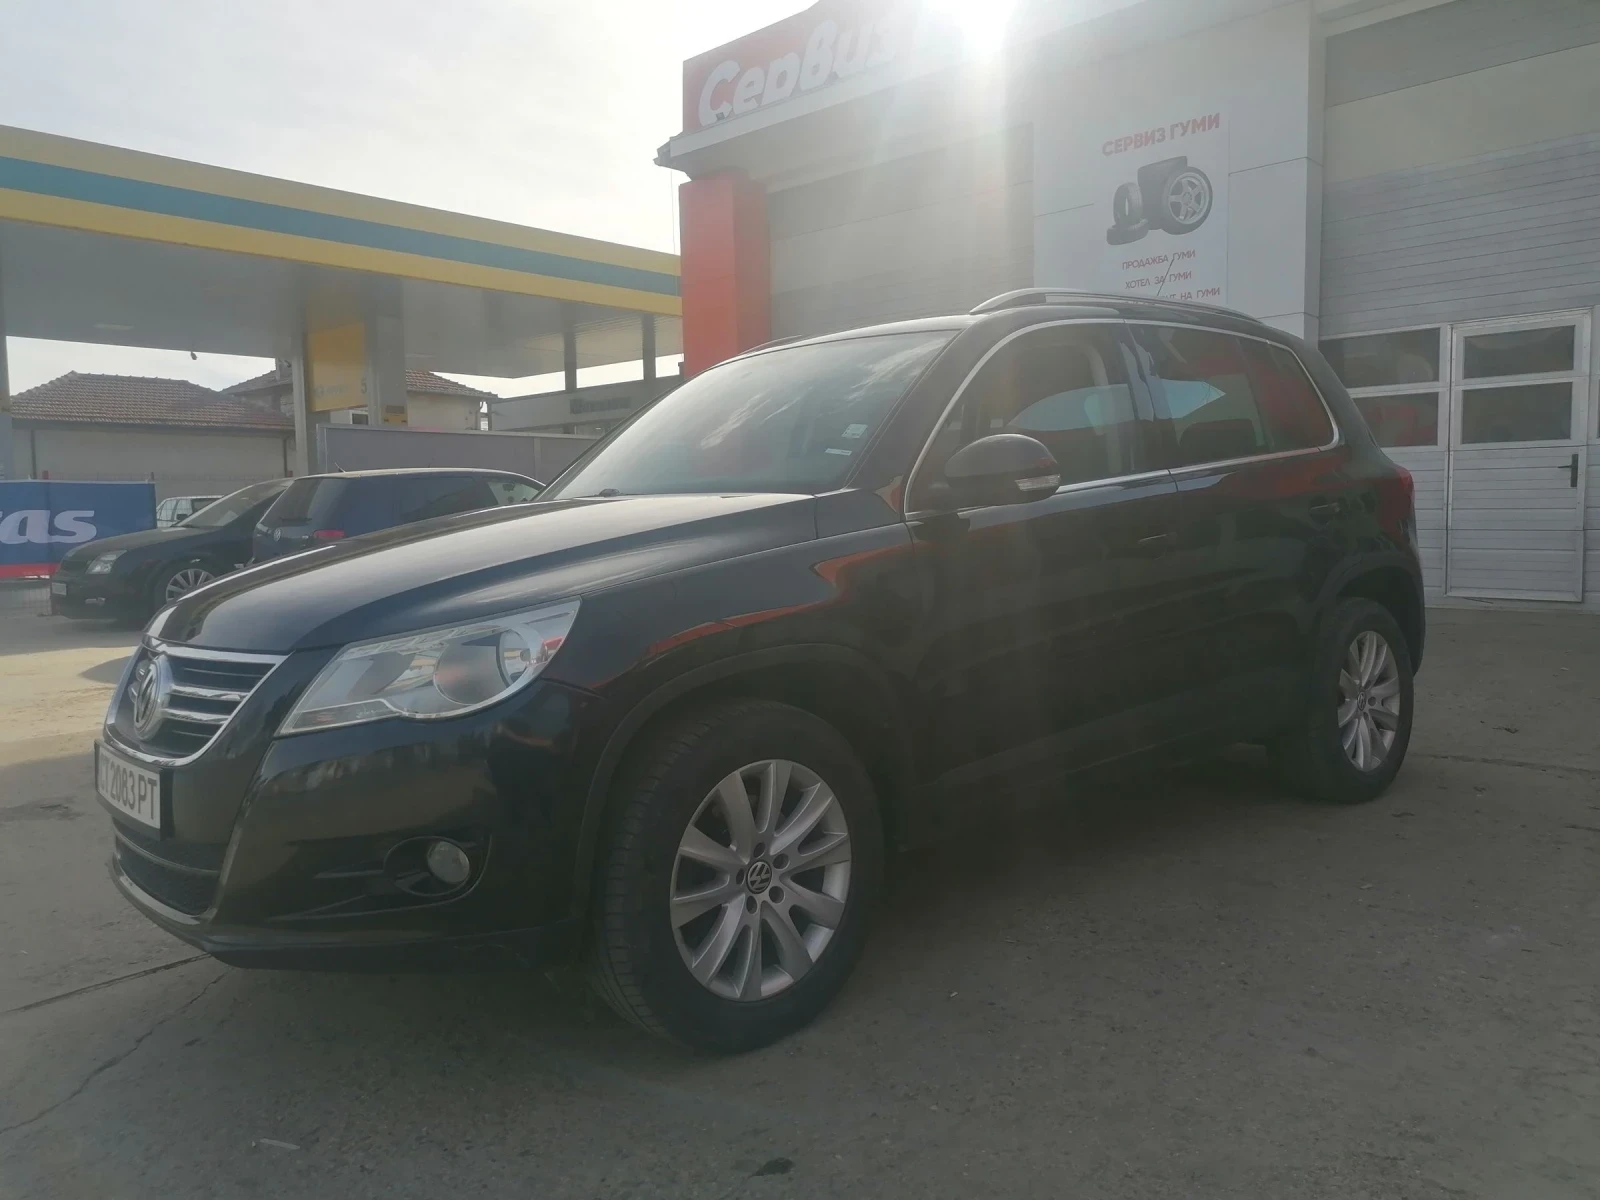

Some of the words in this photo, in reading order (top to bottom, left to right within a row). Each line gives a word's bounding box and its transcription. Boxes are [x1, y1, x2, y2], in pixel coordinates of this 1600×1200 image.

[1102, 127, 1166, 156] СЕРВИЗ
[1170, 112, 1220, 140] ГУМИ
[1122, 254, 1169, 270] ПРОДАЖБА
[1172, 249, 1196, 261] ГУМИ
[1125, 278, 1150, 289] ХОТЕЛ
[1154, 275, 1165, 285] ЗА
[1169, 270, 1192, 282] ГУМИ
[1180, 291, 1192, 300] НА
[1196, 287, 1220, 298] ГУМИ
[110, 760, 136, 810] 2083
[138, 773, 157, 820] PT
